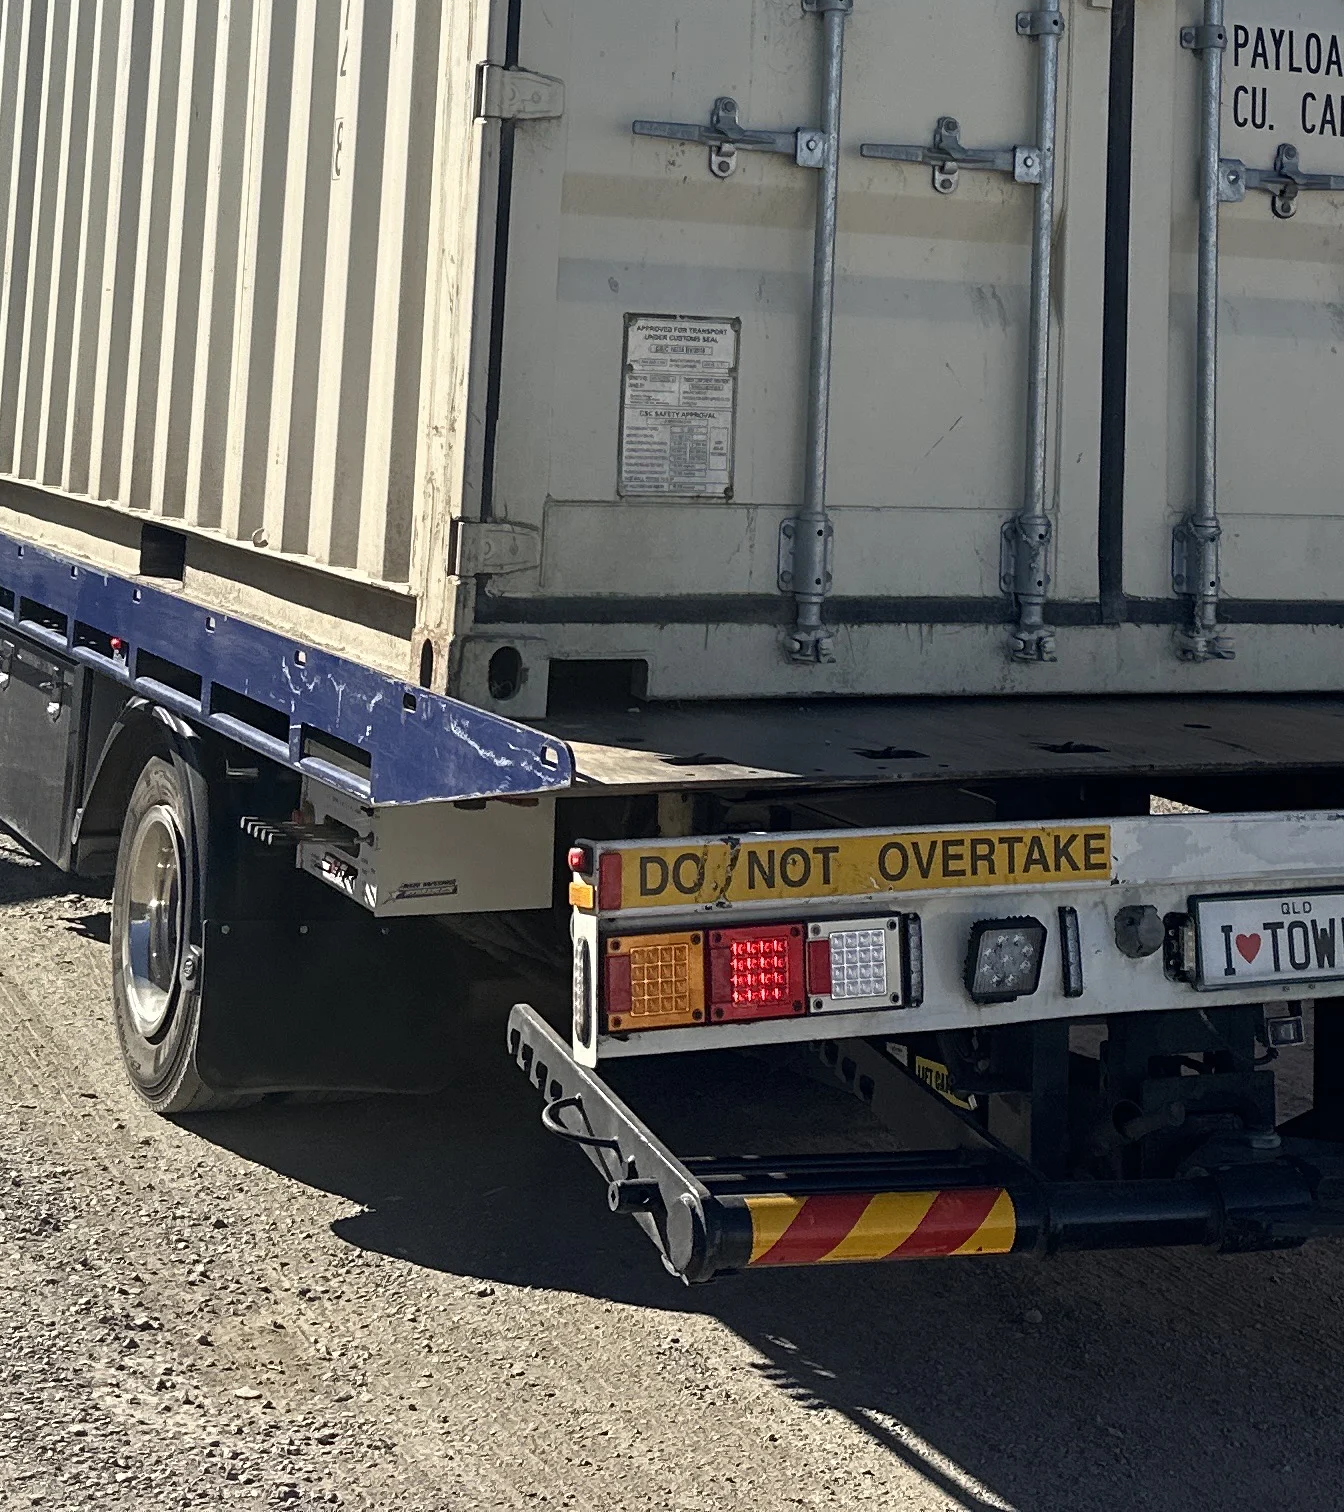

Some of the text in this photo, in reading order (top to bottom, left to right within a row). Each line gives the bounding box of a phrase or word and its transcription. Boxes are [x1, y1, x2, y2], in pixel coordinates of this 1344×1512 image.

[1233, 85, 1274, 131] CU.
[638, 831, 1110, 897] DO NOT OVERTAKE
[1281, 901, 1312, 915] QLD
